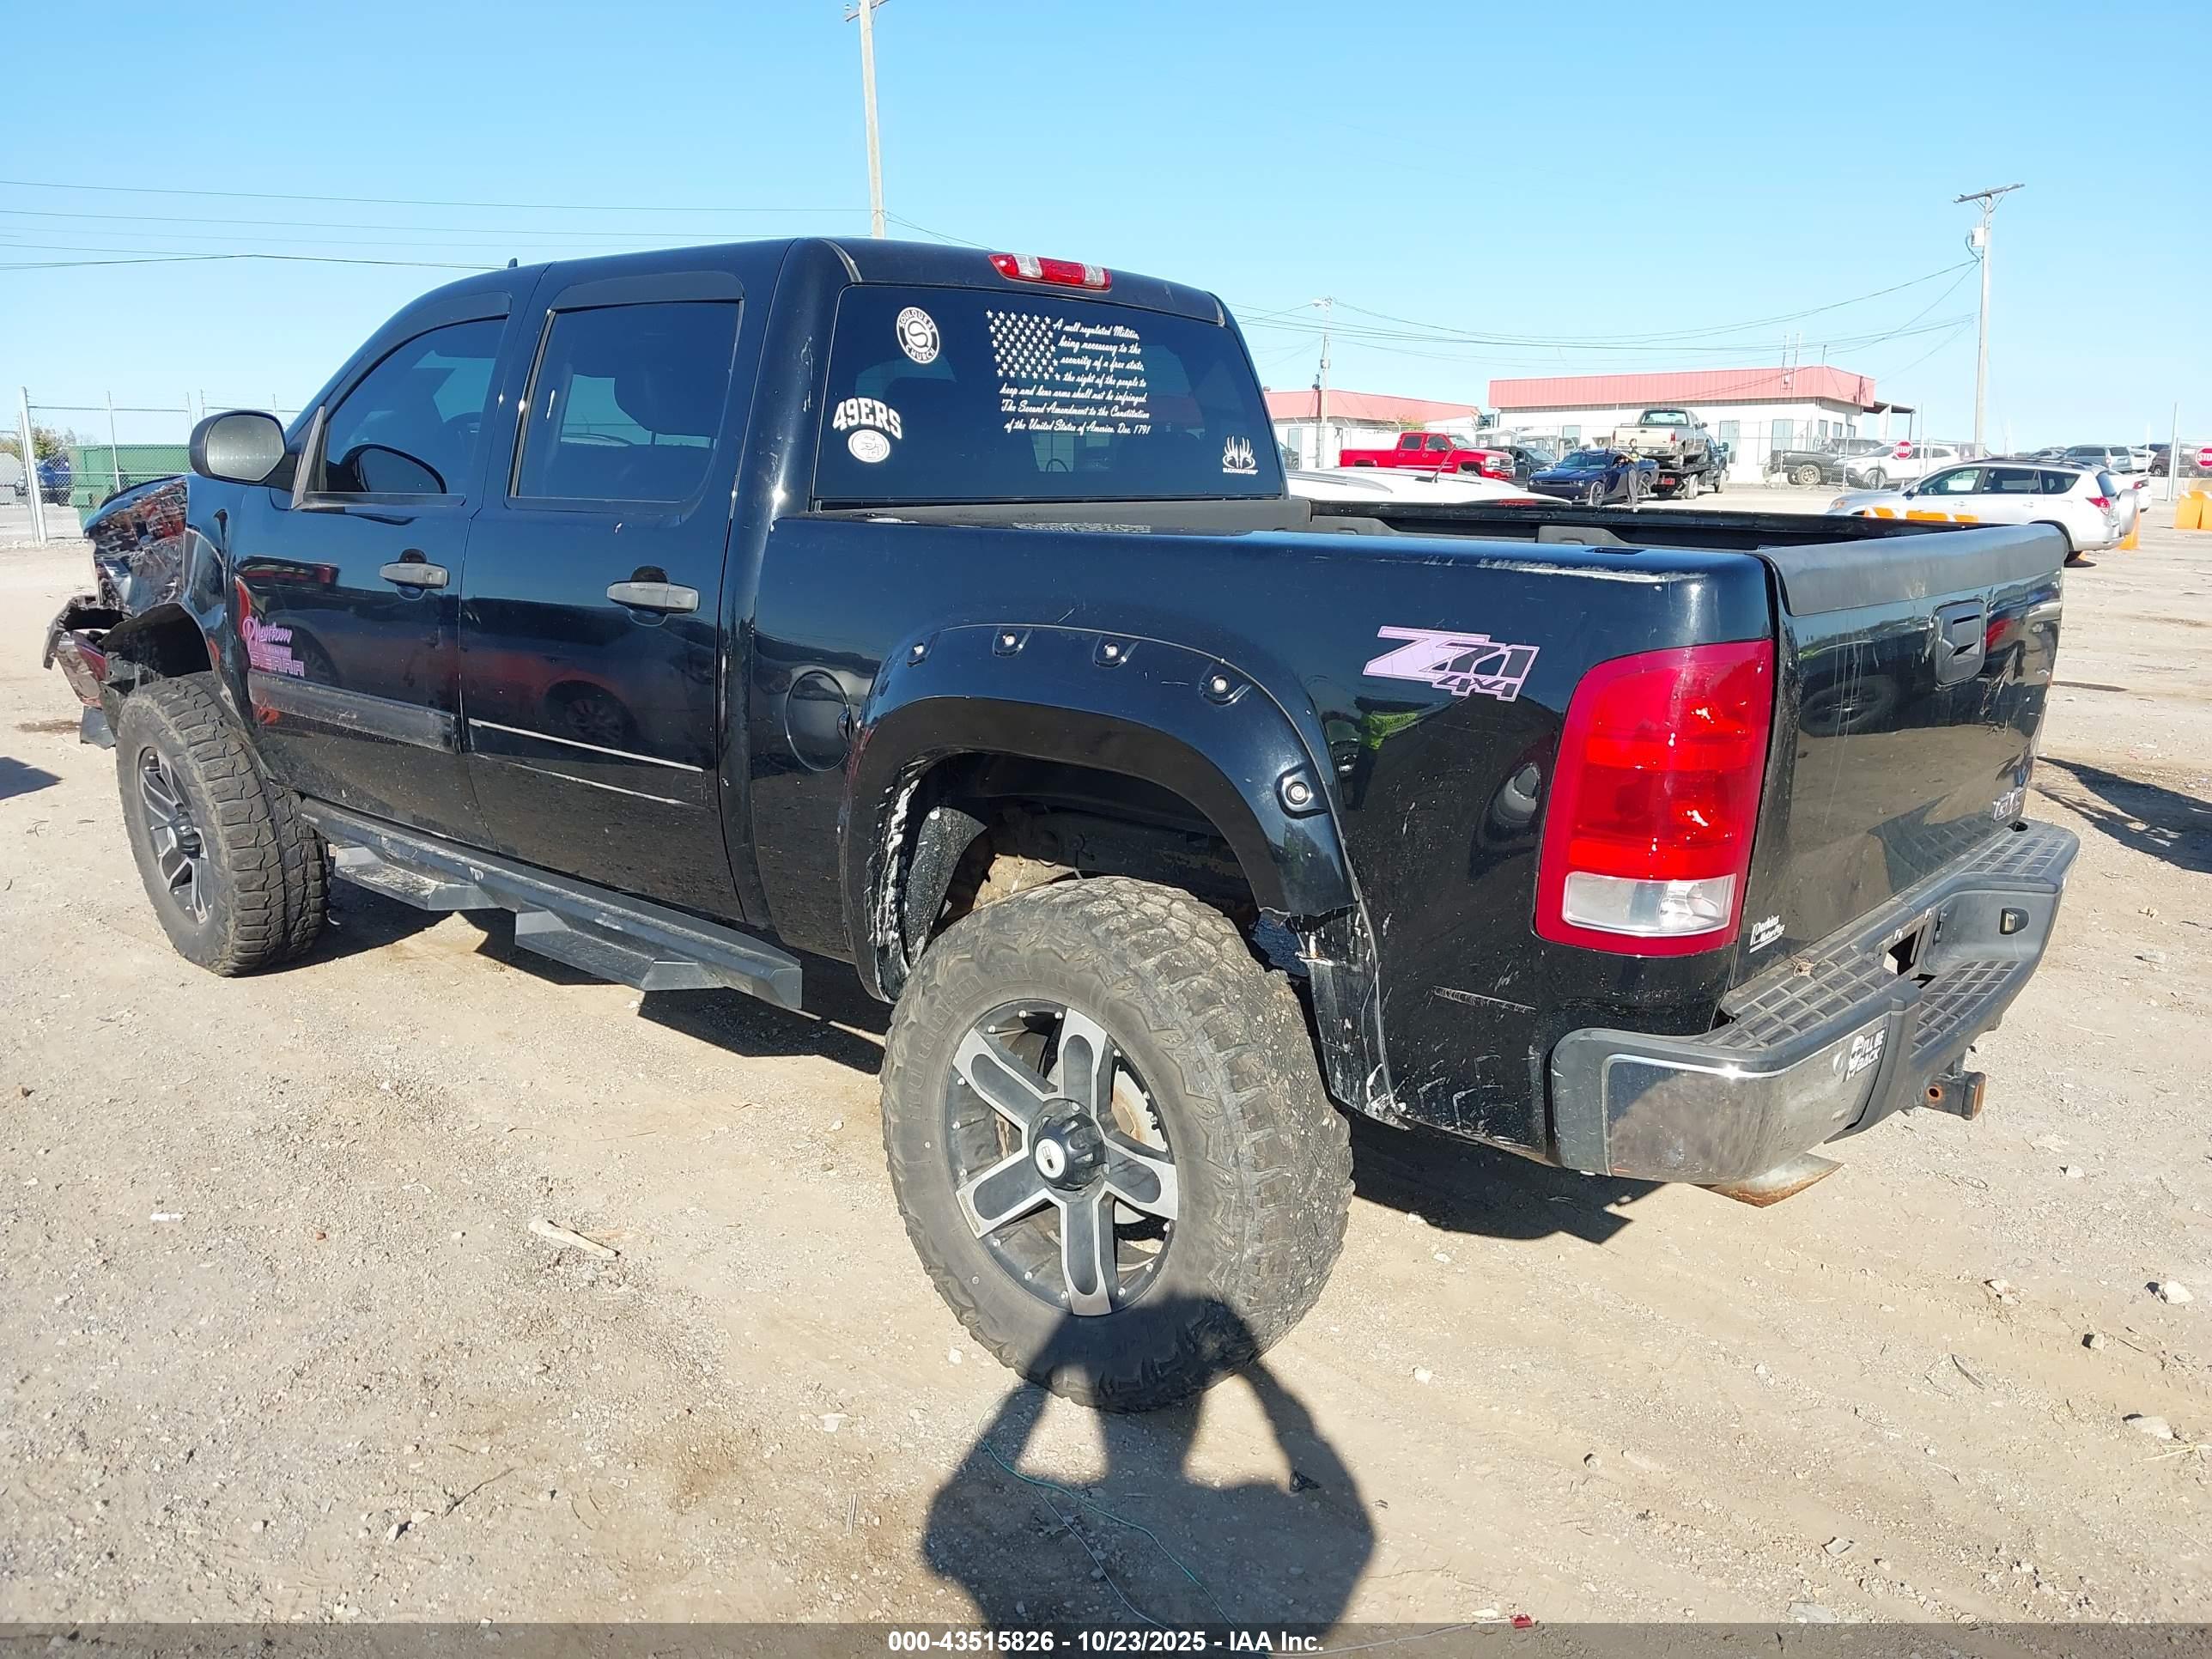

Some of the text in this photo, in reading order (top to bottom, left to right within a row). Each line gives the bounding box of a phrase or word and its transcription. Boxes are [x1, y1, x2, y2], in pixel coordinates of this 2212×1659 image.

[1053, 318, 1064, 330] A
[1079, 325, 1113, 338] regulated
[905, 344, 937, 361] CHURCH
[1058, 335, 1141, 356] being necessary to the
[1060, 356, 1091, 371] security
[1092, 356, 1104, 371] of
[1109, 356, 1124, 373] free
[1063, 372, 1146, 388] the right of the people to
[1000, 382, 1018, 398] keep
[1018, 385, 1034, 396] and
[1036, 385, 1052, 397] bear
[1053, 389, 1071, 398] arms
[1071, 387, 1092, 399] shall
[1092, 391, 1105, 400] not
[1105, 391, 1115, 401] be
[832, 398, 902, 440] 49ERS
[1001, 399, 1150, 419] The Second Amendment to the Constitution
[1004, 418, 1014, 433] of
[1013, 419, 1025, 429] the
[1029, 418, 1053, 430] United
[1054, 419, 1077, 432] States
[1078, 422, 1086, 436] of
[1133, 424, 1152, 434] 1791
[1894, 446, 1911, 454] STOP
[242, 616, 293, 649] Phantom
[250, 651, 305, 677] SIERRA
[1363, 625, 1540, 683] Z71
[1993, 787, 2025, 821] GMC
[1874, 1029, 1886, 1048] BE
[1856, 1046, 1881, 1073] BACK
